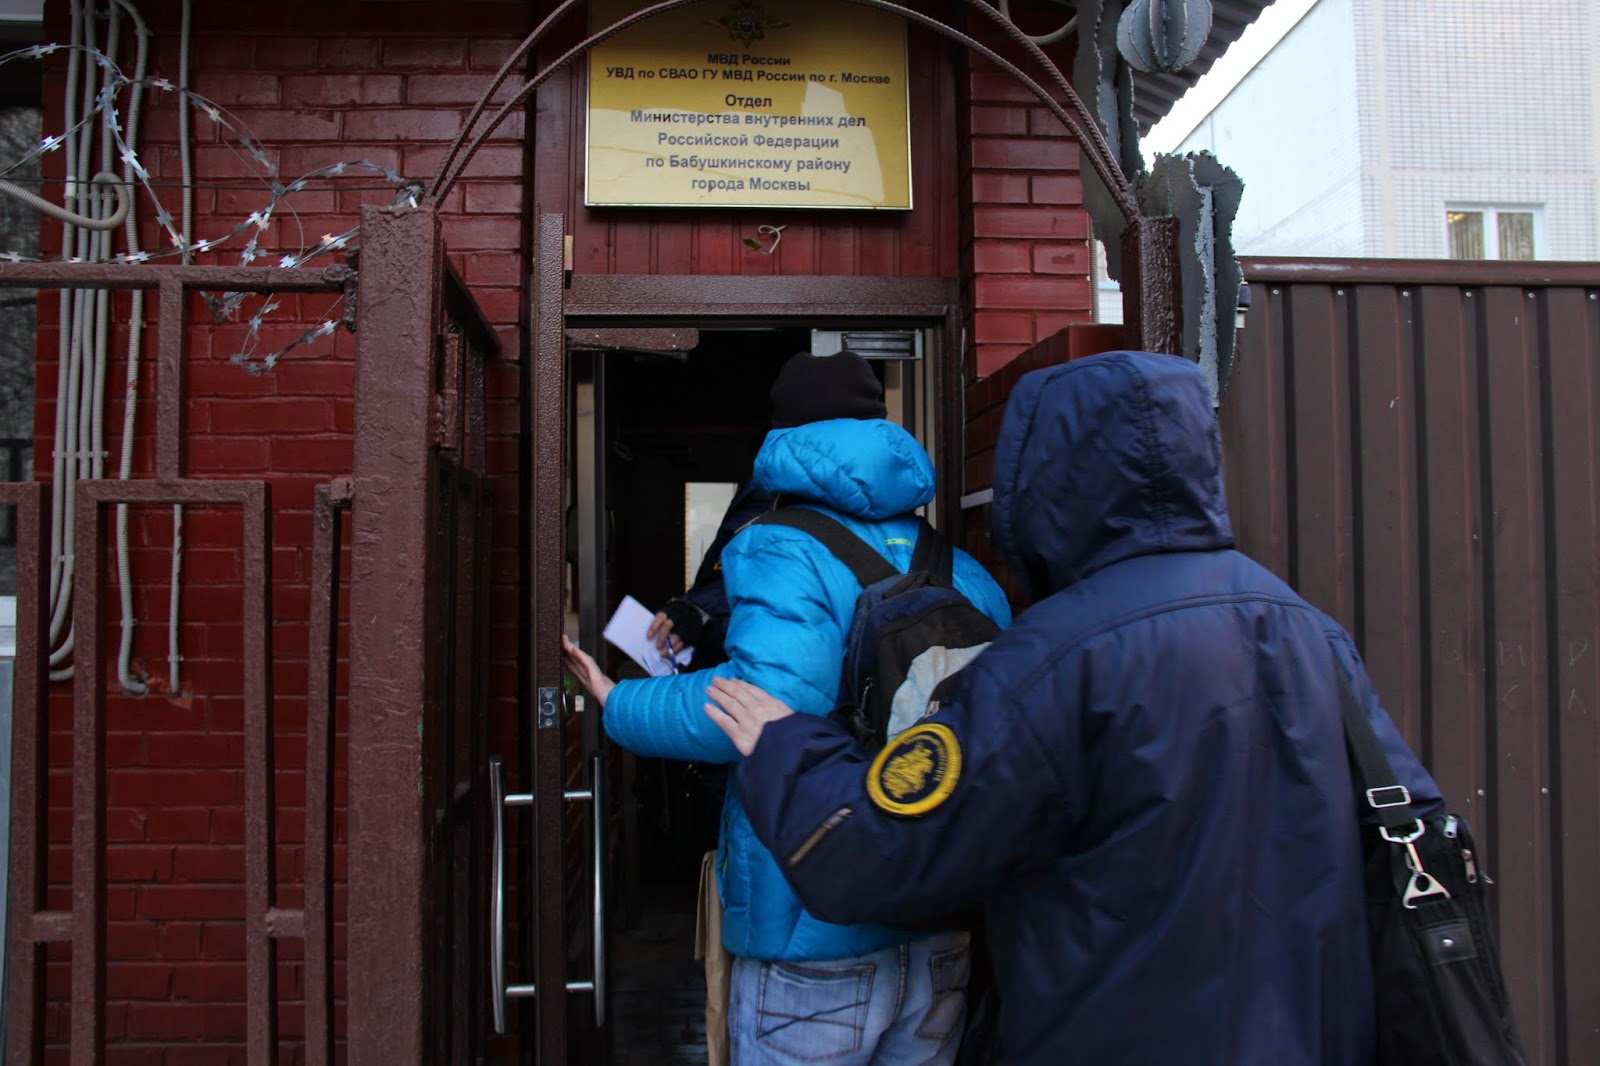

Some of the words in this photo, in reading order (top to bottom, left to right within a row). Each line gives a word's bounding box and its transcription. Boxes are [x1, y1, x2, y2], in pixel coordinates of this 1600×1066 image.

[708, 53, 738, 66] МВД
[742, 54, 791, 66] России
[606, 67, 634, 80] УВД
[639, 69, 654, 79] по
[658, 68, 698, 79] СВАО
[703, 69, 718, 80] ГУ
[722, 69, 753, 82] МВД
[757, 70, 806, 82] России
[809, 73, 826, 82] по
[829, 74, 838, 83] г.
[841, 72, 891, 84] Москве
[725, 93, 772, 108] Отдел
[630, 110, 740, 126] Министерства
[745, 113, 834, 128] внутренних
[838, 116, 866, 128] дел
[658, 132, 748, 147] Российской
[753, 134, 839, 150] Федерации
[646, 157, 665, 168] по
[669, 155, 792, 172] Бабушкинскому
[797, 157, 851, 174] району
[692, 179, 744, 193] города
[749, 177, 811, 192] Москвы
